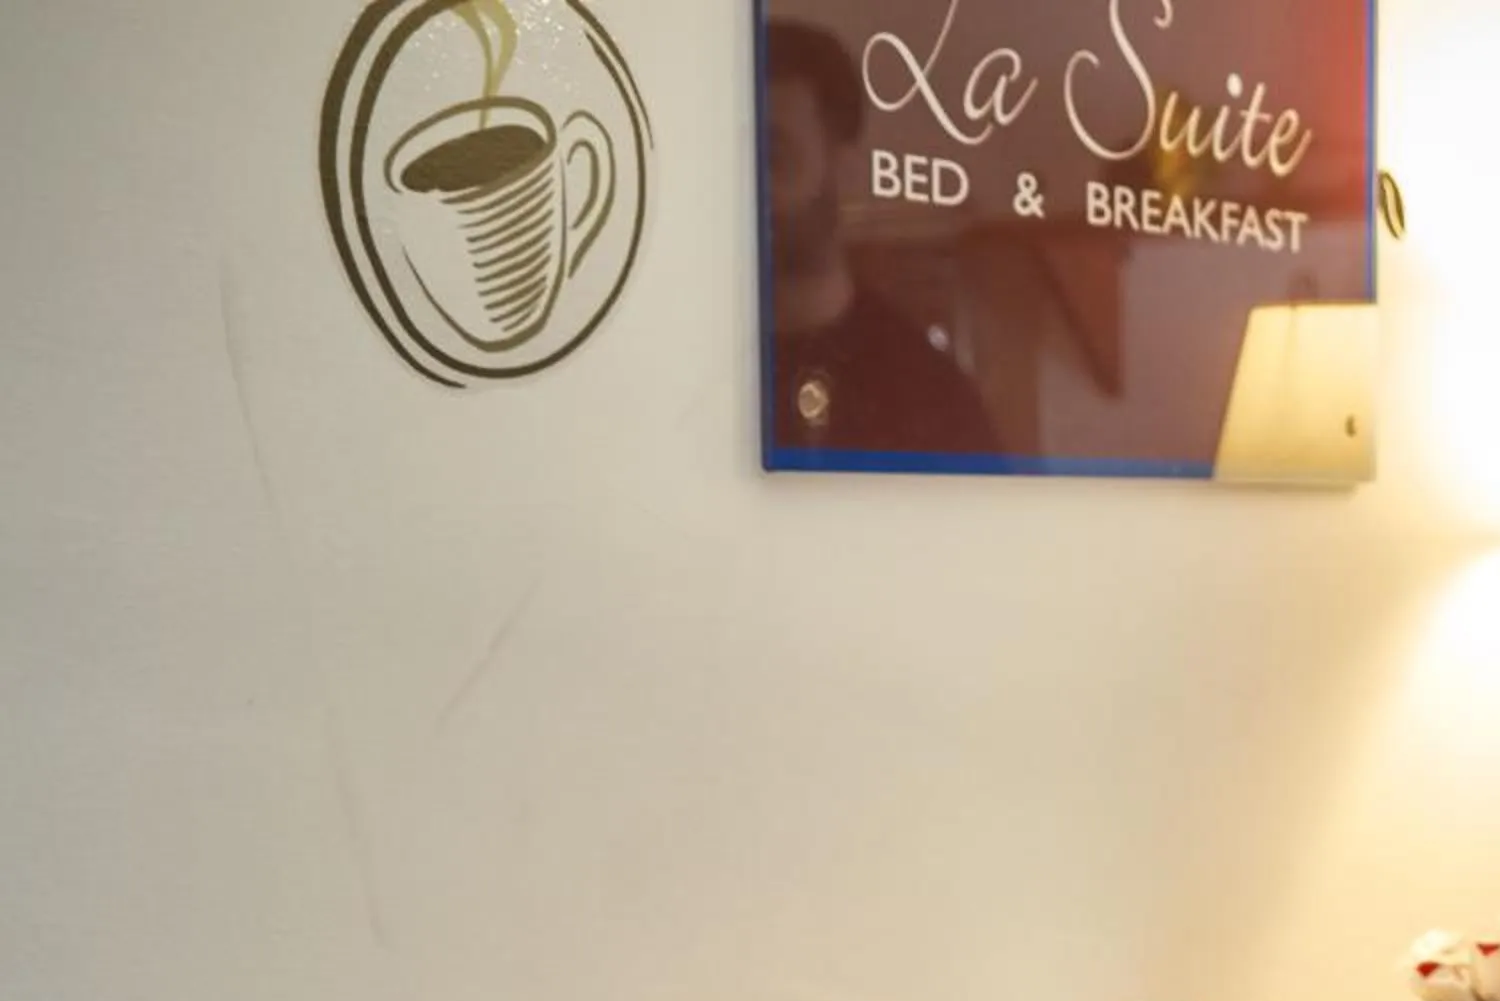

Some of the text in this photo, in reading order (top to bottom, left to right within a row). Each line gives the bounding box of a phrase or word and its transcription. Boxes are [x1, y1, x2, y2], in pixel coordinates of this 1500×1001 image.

[862, 0, 1313, 177] La Suite
[871, 148, 1309, 255] BED & BREAKFAST
